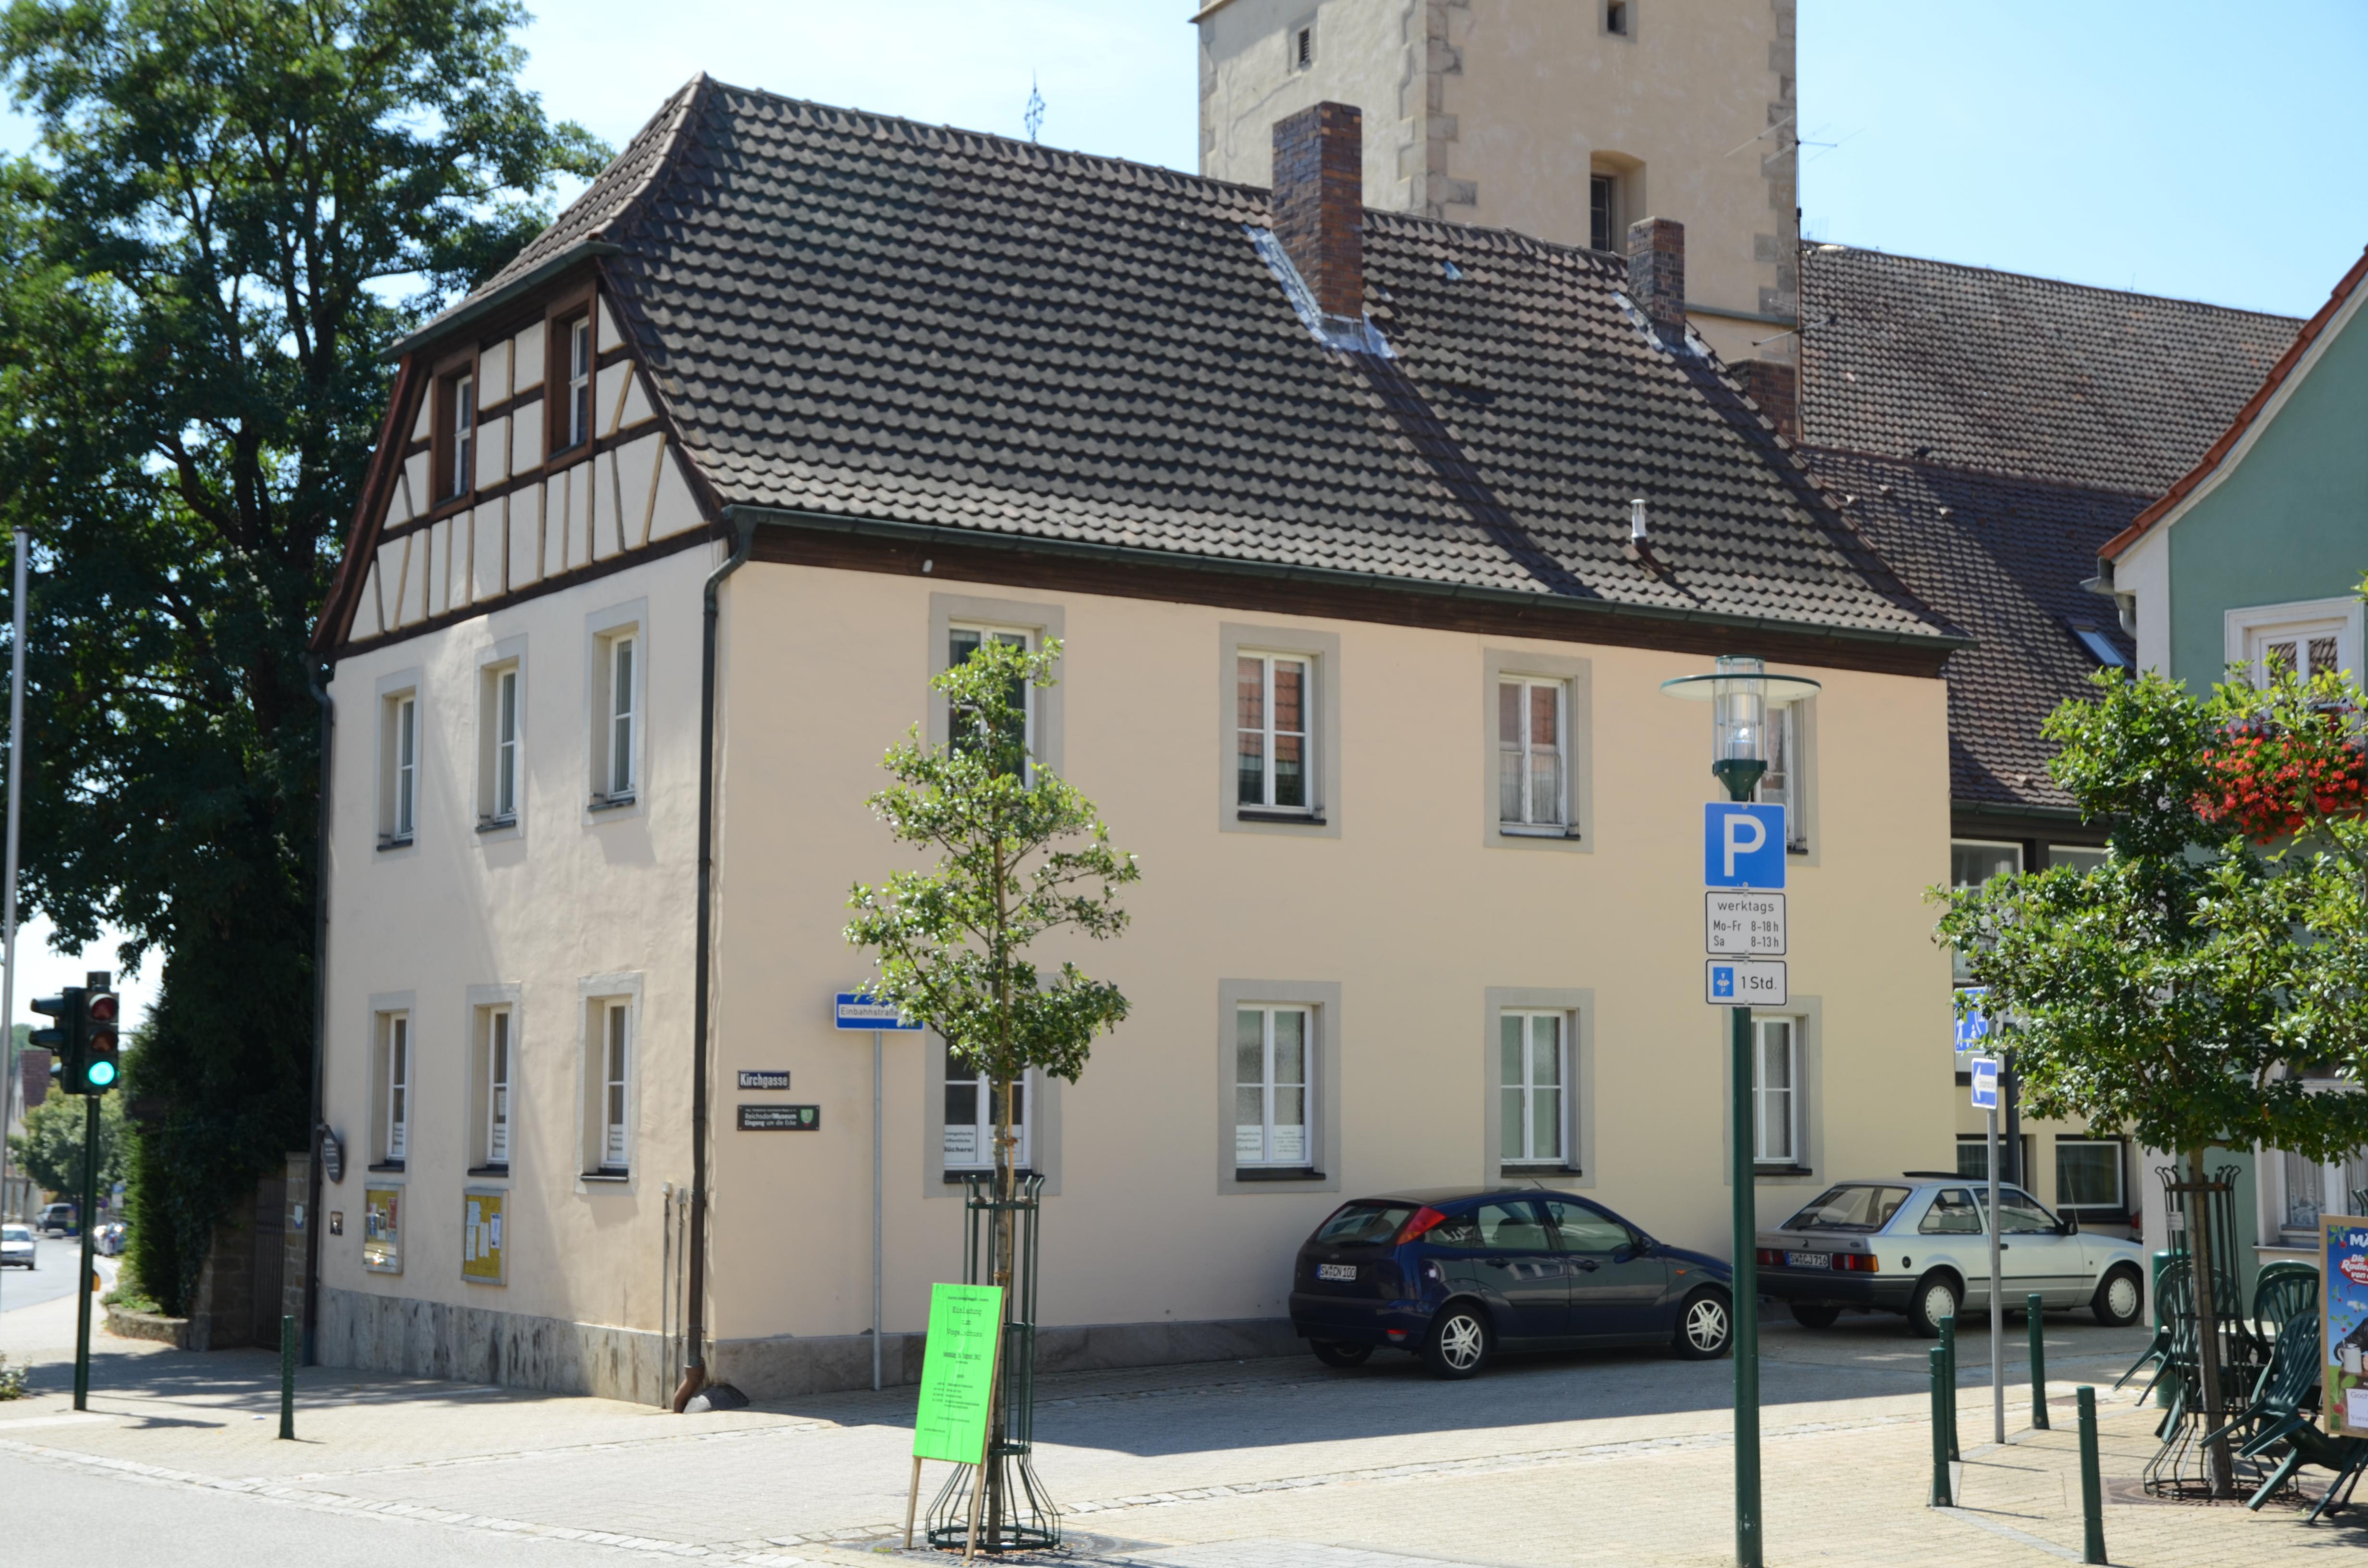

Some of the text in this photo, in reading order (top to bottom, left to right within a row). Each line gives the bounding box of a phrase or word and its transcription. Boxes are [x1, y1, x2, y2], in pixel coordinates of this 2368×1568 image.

[1724, 814, 1766, 877] P
[1717, 900, 1774, 914] werktags
[1714, 920, 1778, 931] Mo-Fr 8-18 h
[1714, 935, 1779, 947] Sa 8-13 h
[1741, 976, 1777, 990] 1 Std.
[841, 1006, 899, 1016] Einbahnstraße
[740, 1073, 788, 1089] Kirchgasse
[1814, 1255, 1827, 1265] 716
[2351, 1254, 2365, 1262] Die
[2341, 1259, 2368, 1272] Radie
[952, 1306, 982, 1317] Einladung
